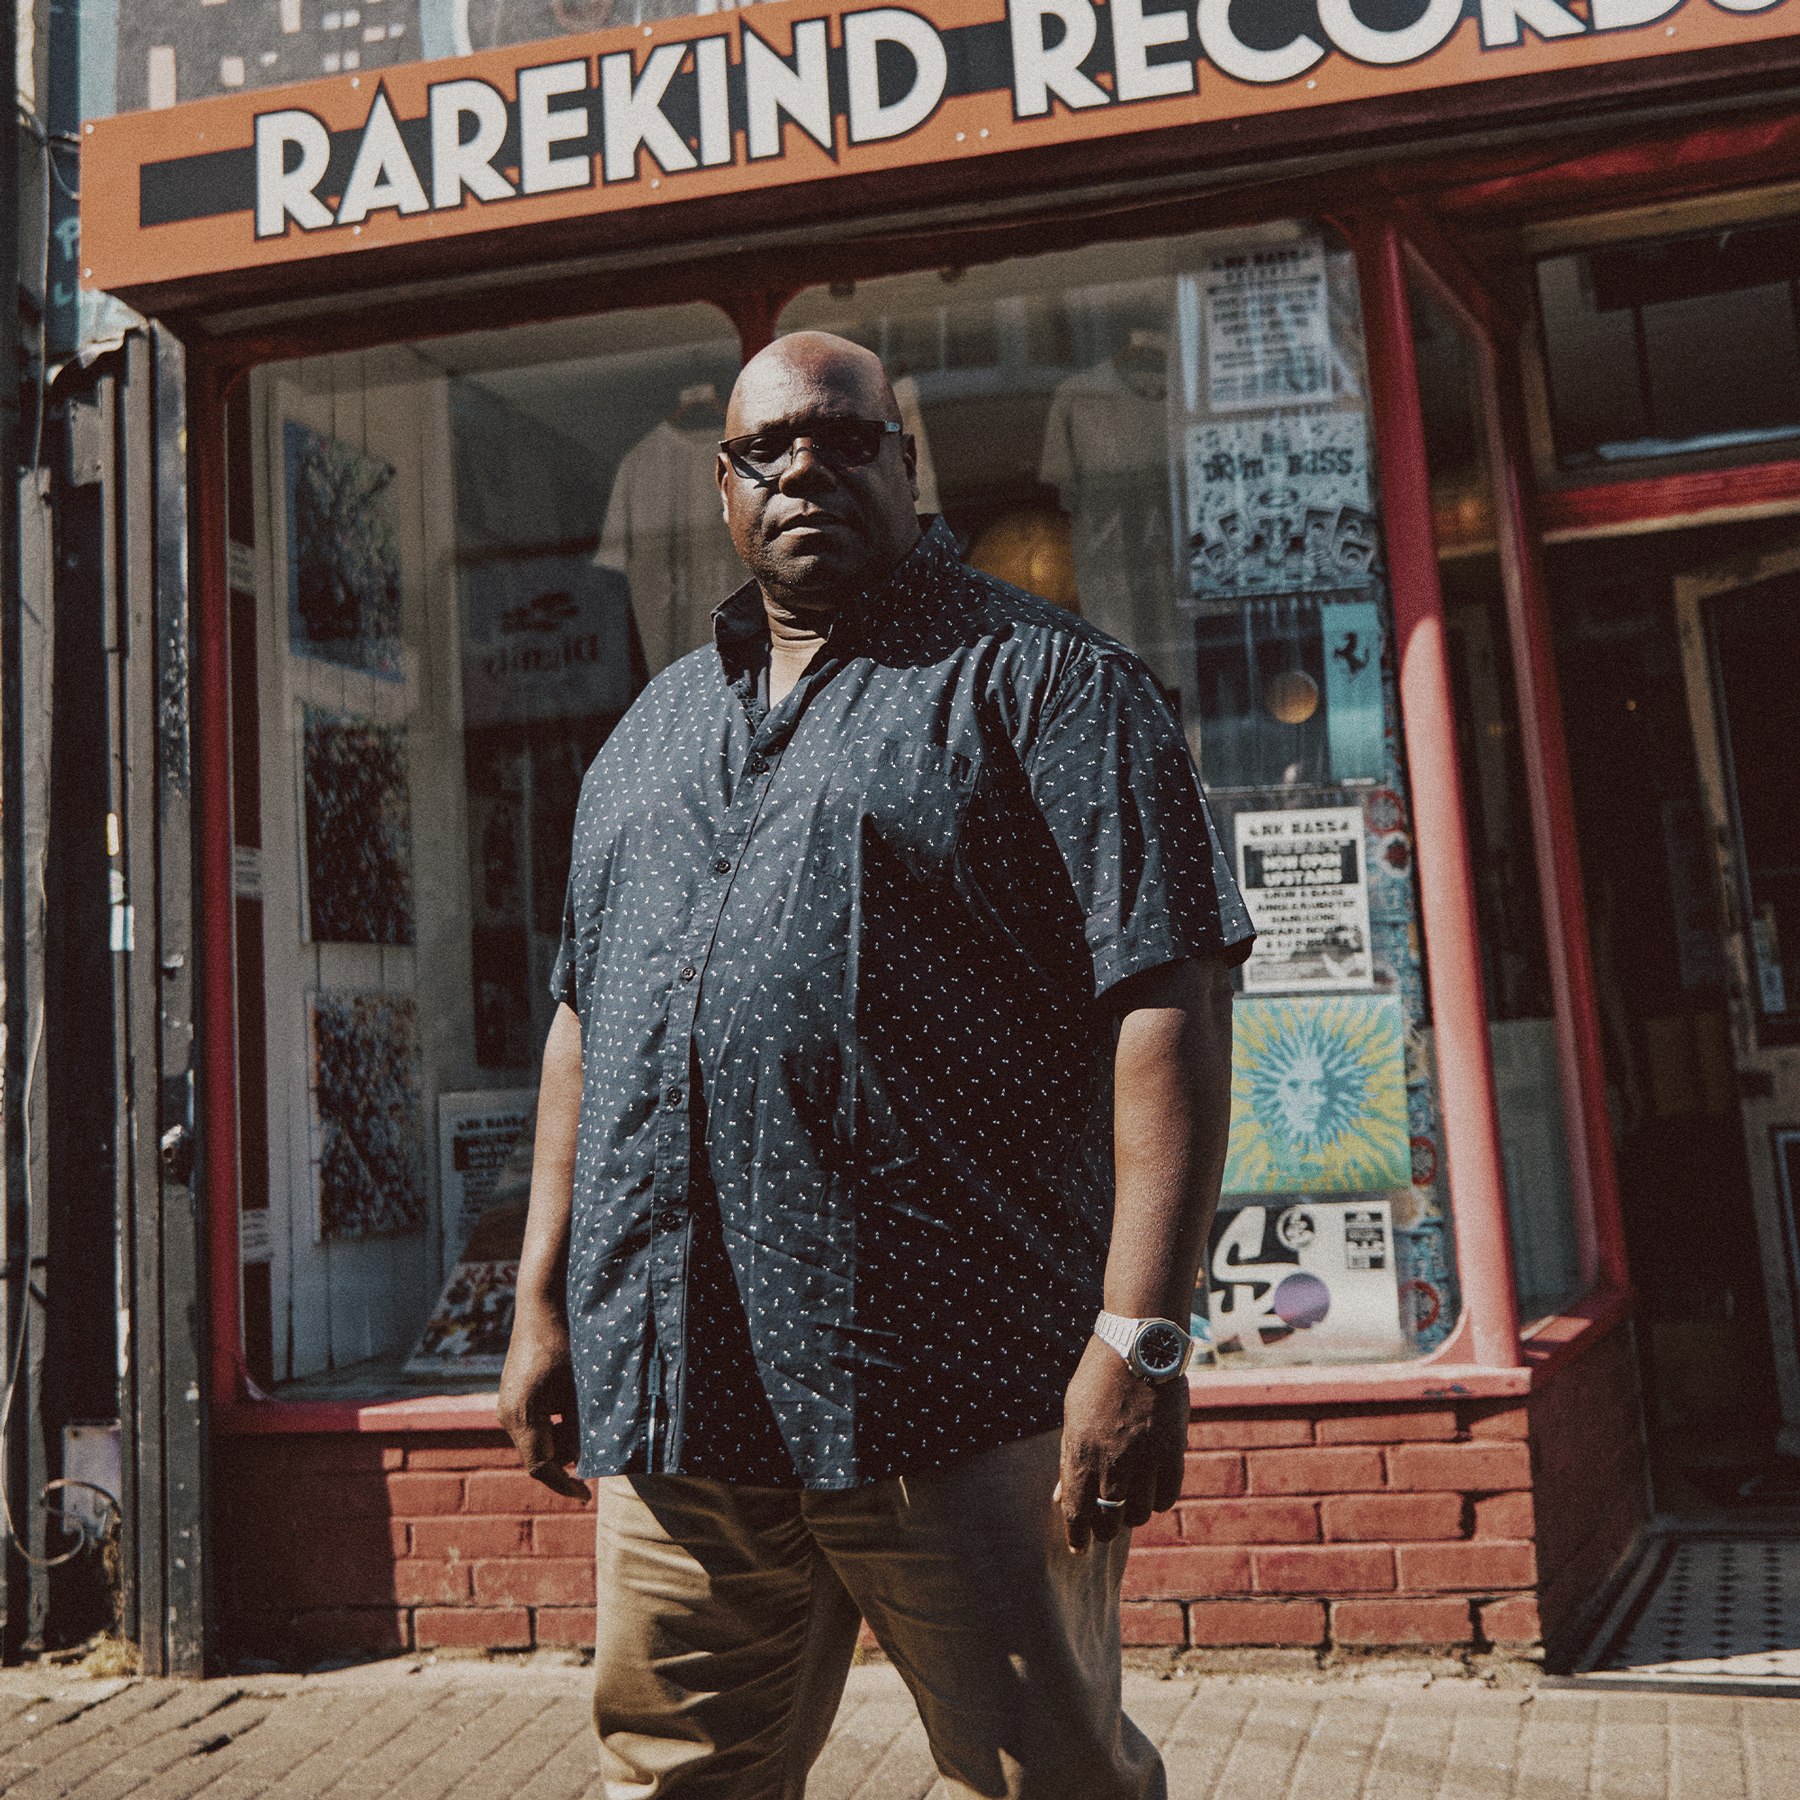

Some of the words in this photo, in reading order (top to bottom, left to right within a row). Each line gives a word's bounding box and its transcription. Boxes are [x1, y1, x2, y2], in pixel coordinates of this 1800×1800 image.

[255, 6, 949, 239] RAREKIND
[1008, 0, 1788, 119] RECO
[1300, 853, 1342, 869] OPEN
